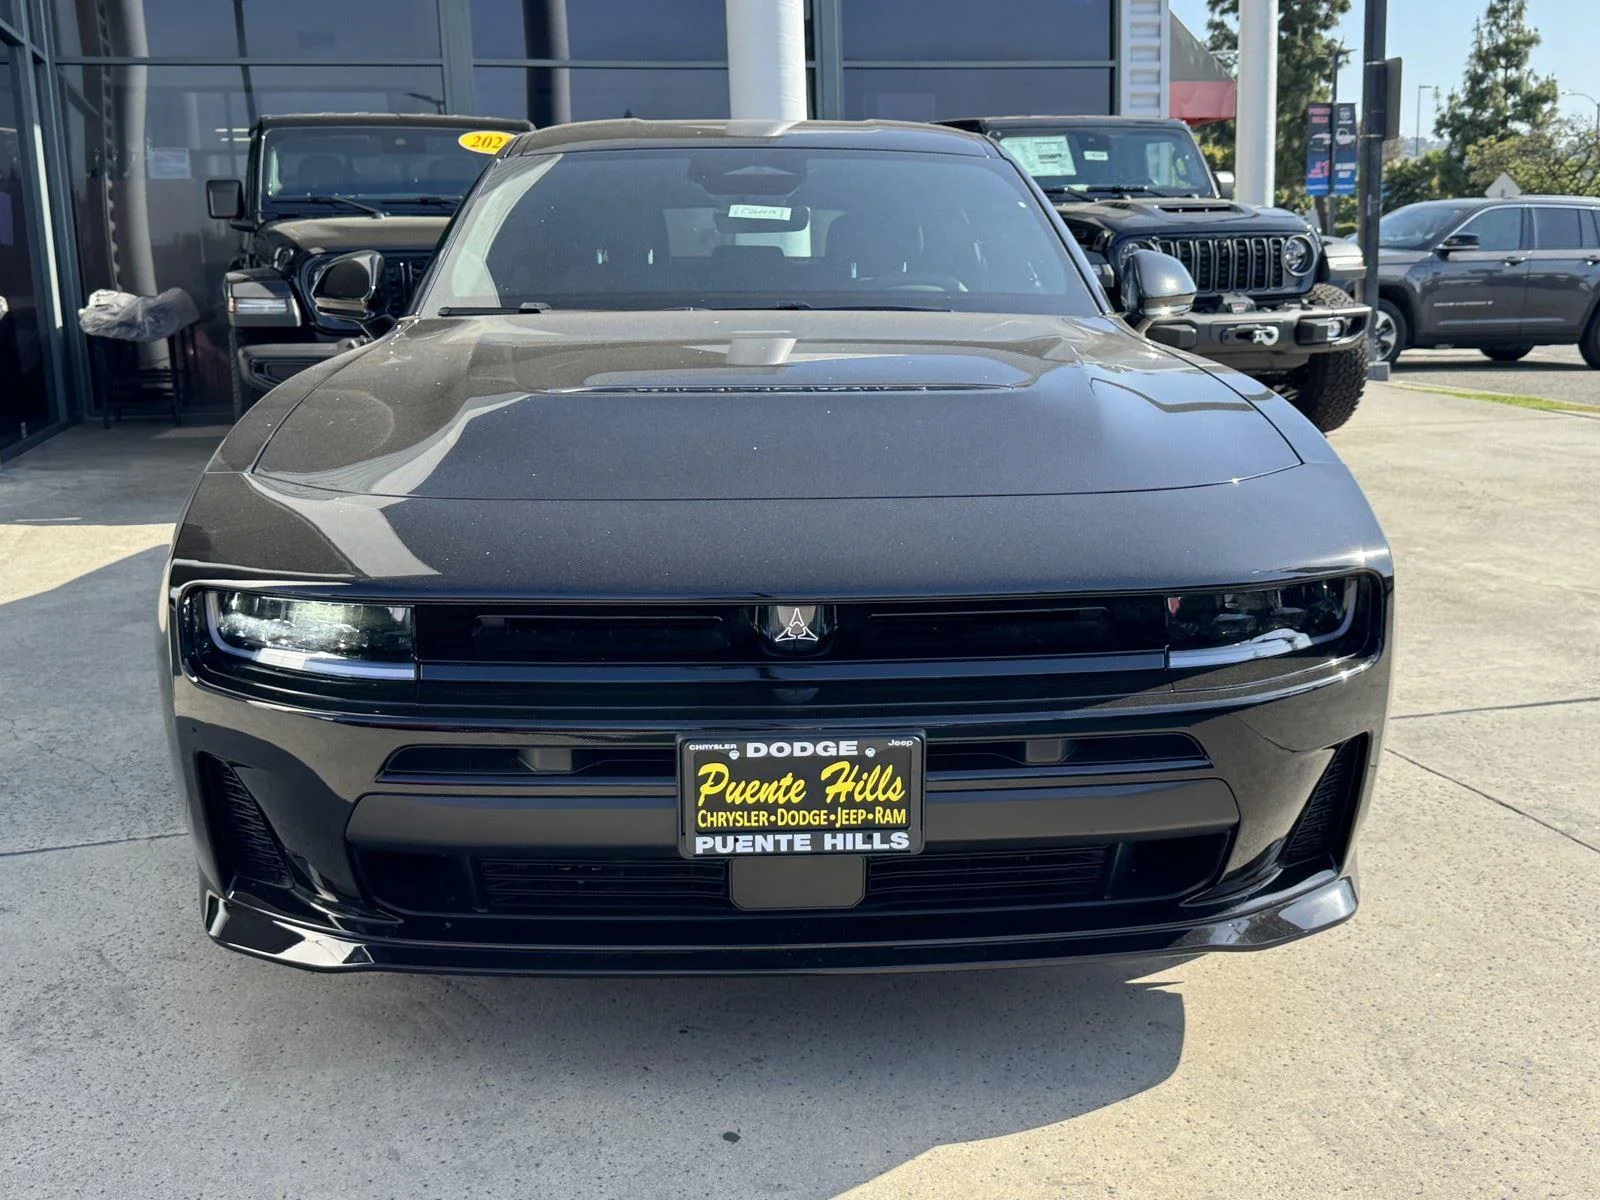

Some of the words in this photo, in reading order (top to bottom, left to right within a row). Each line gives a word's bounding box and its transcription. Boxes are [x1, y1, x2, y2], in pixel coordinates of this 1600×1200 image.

[471, 136, 503, 149] 202
[689, 743, 737, 751] CHRYSLER
[746, 741, 858, 758] DODGE
[887, 739, 914, 748] Jeep
[697, 762, 807, 807] Puente
[820, 760, 906, 804] Hills
[695, 833, 812, 854] PUENTE
[823, 831, 910, 851] HILLS
